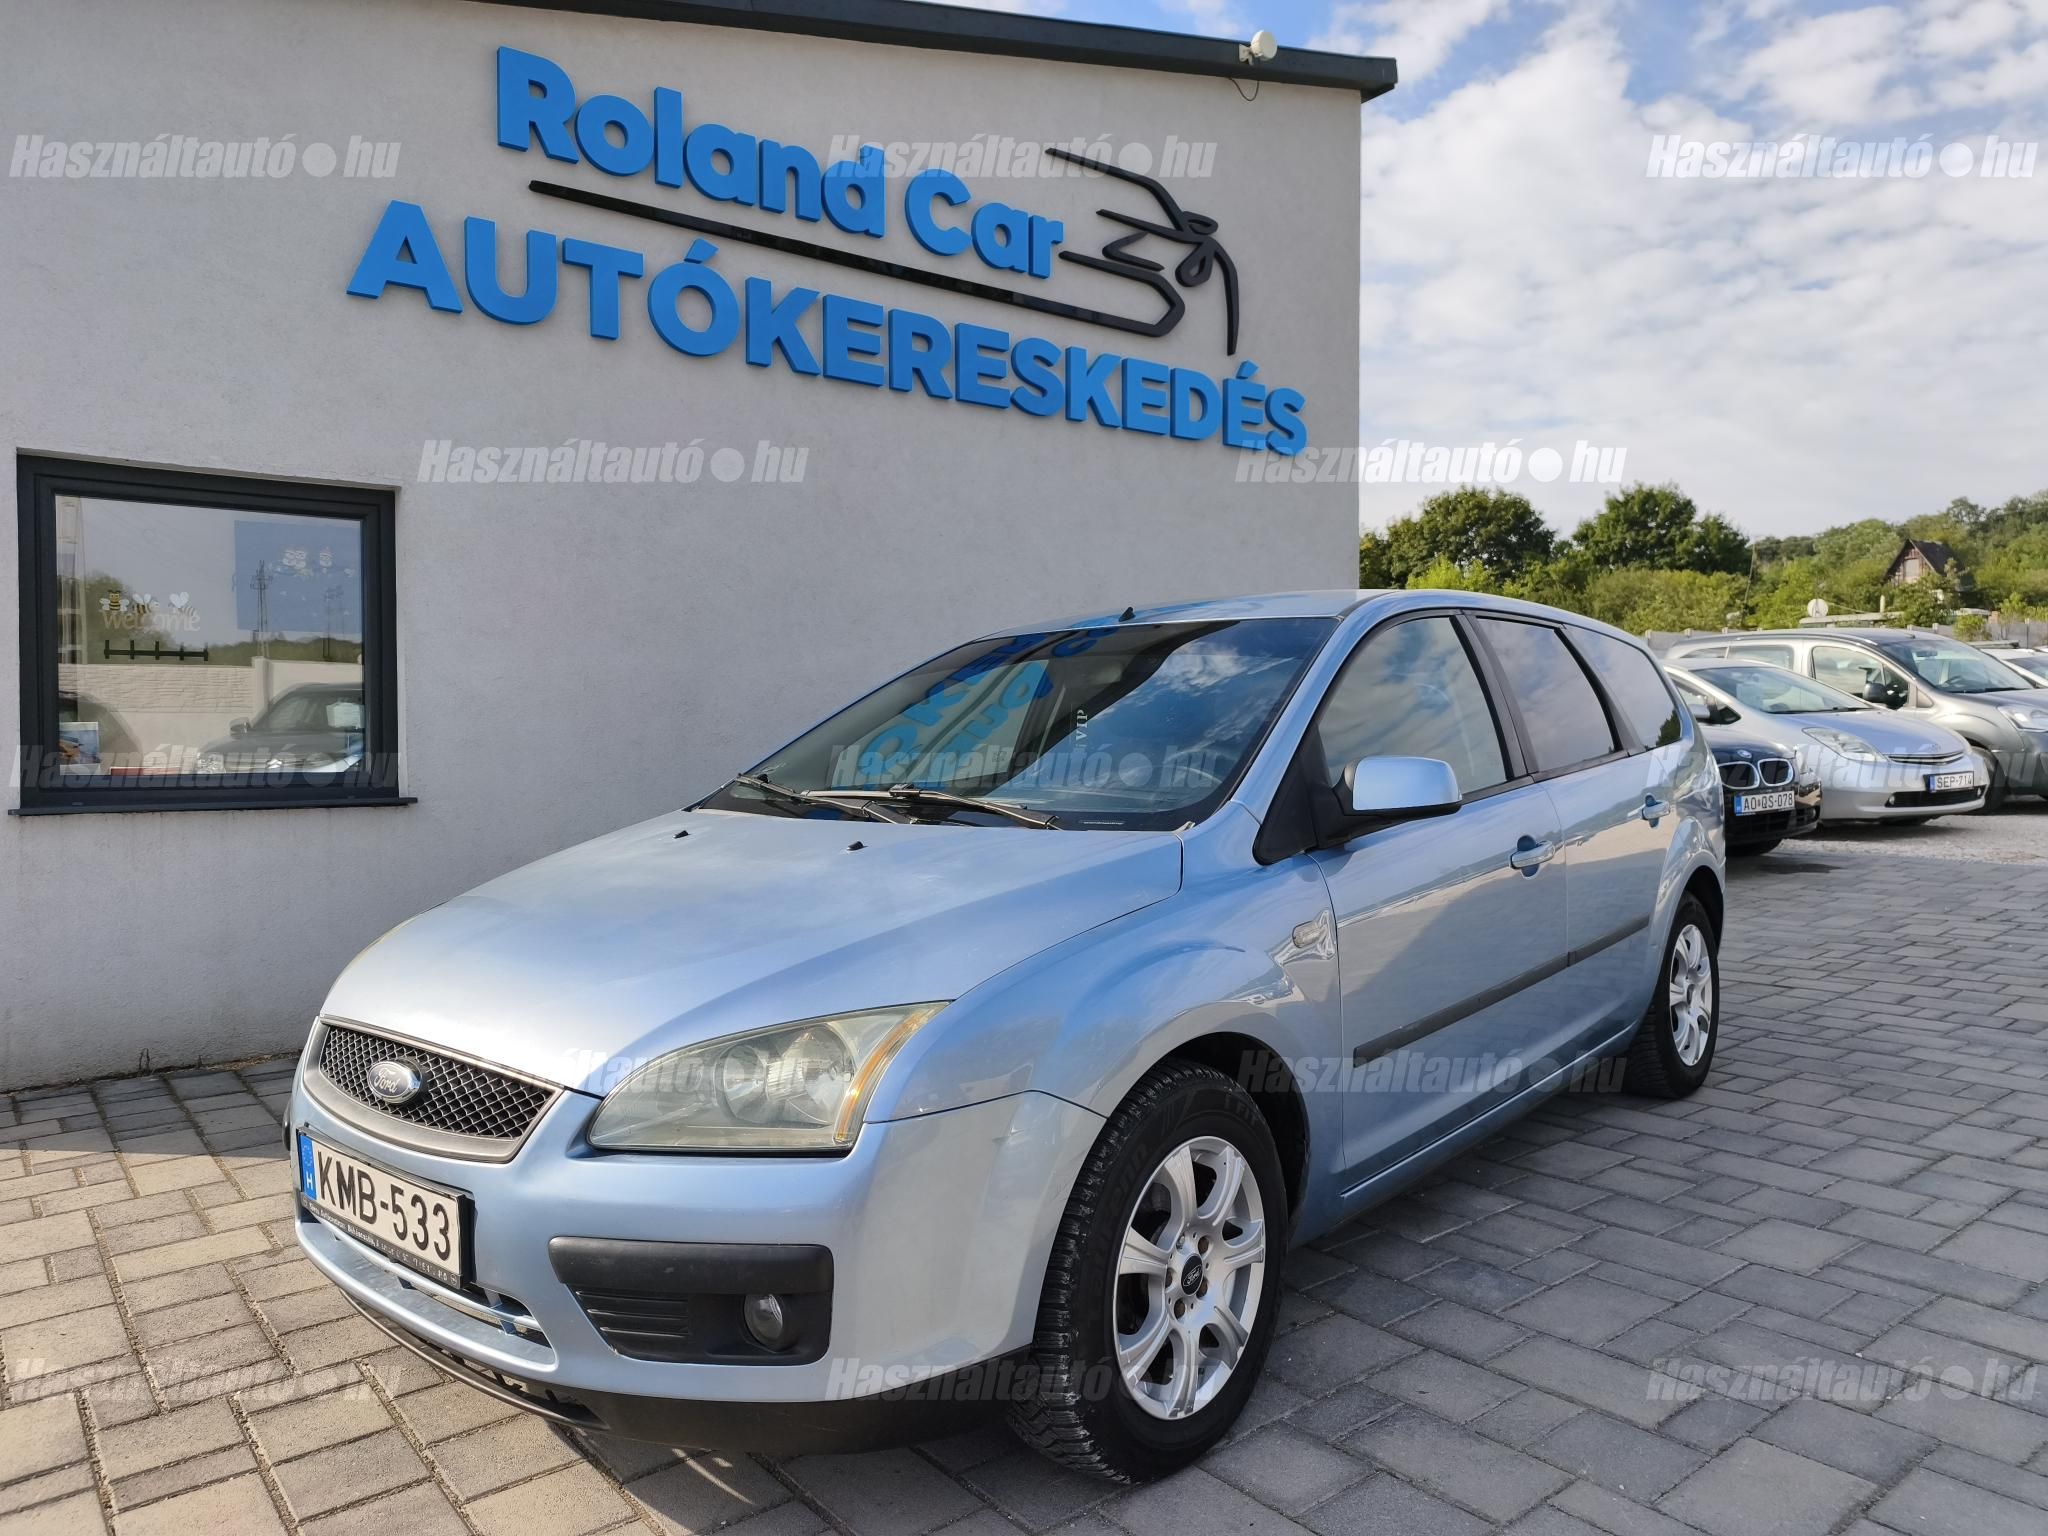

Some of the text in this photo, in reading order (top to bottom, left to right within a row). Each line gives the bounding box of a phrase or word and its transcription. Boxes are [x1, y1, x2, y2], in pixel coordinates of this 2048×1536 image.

[497, 46, 1064, 279] Roland Car
[347, 200, 1308, 457] AUTÓKERESKEDÉS
[1937, 775, 1972, 788] SEP-714
[373, 1067, 401, 1093] Ford
[305, 1171, 313, 1191] H
[317, 1151, 451, 1261] KMB-533
